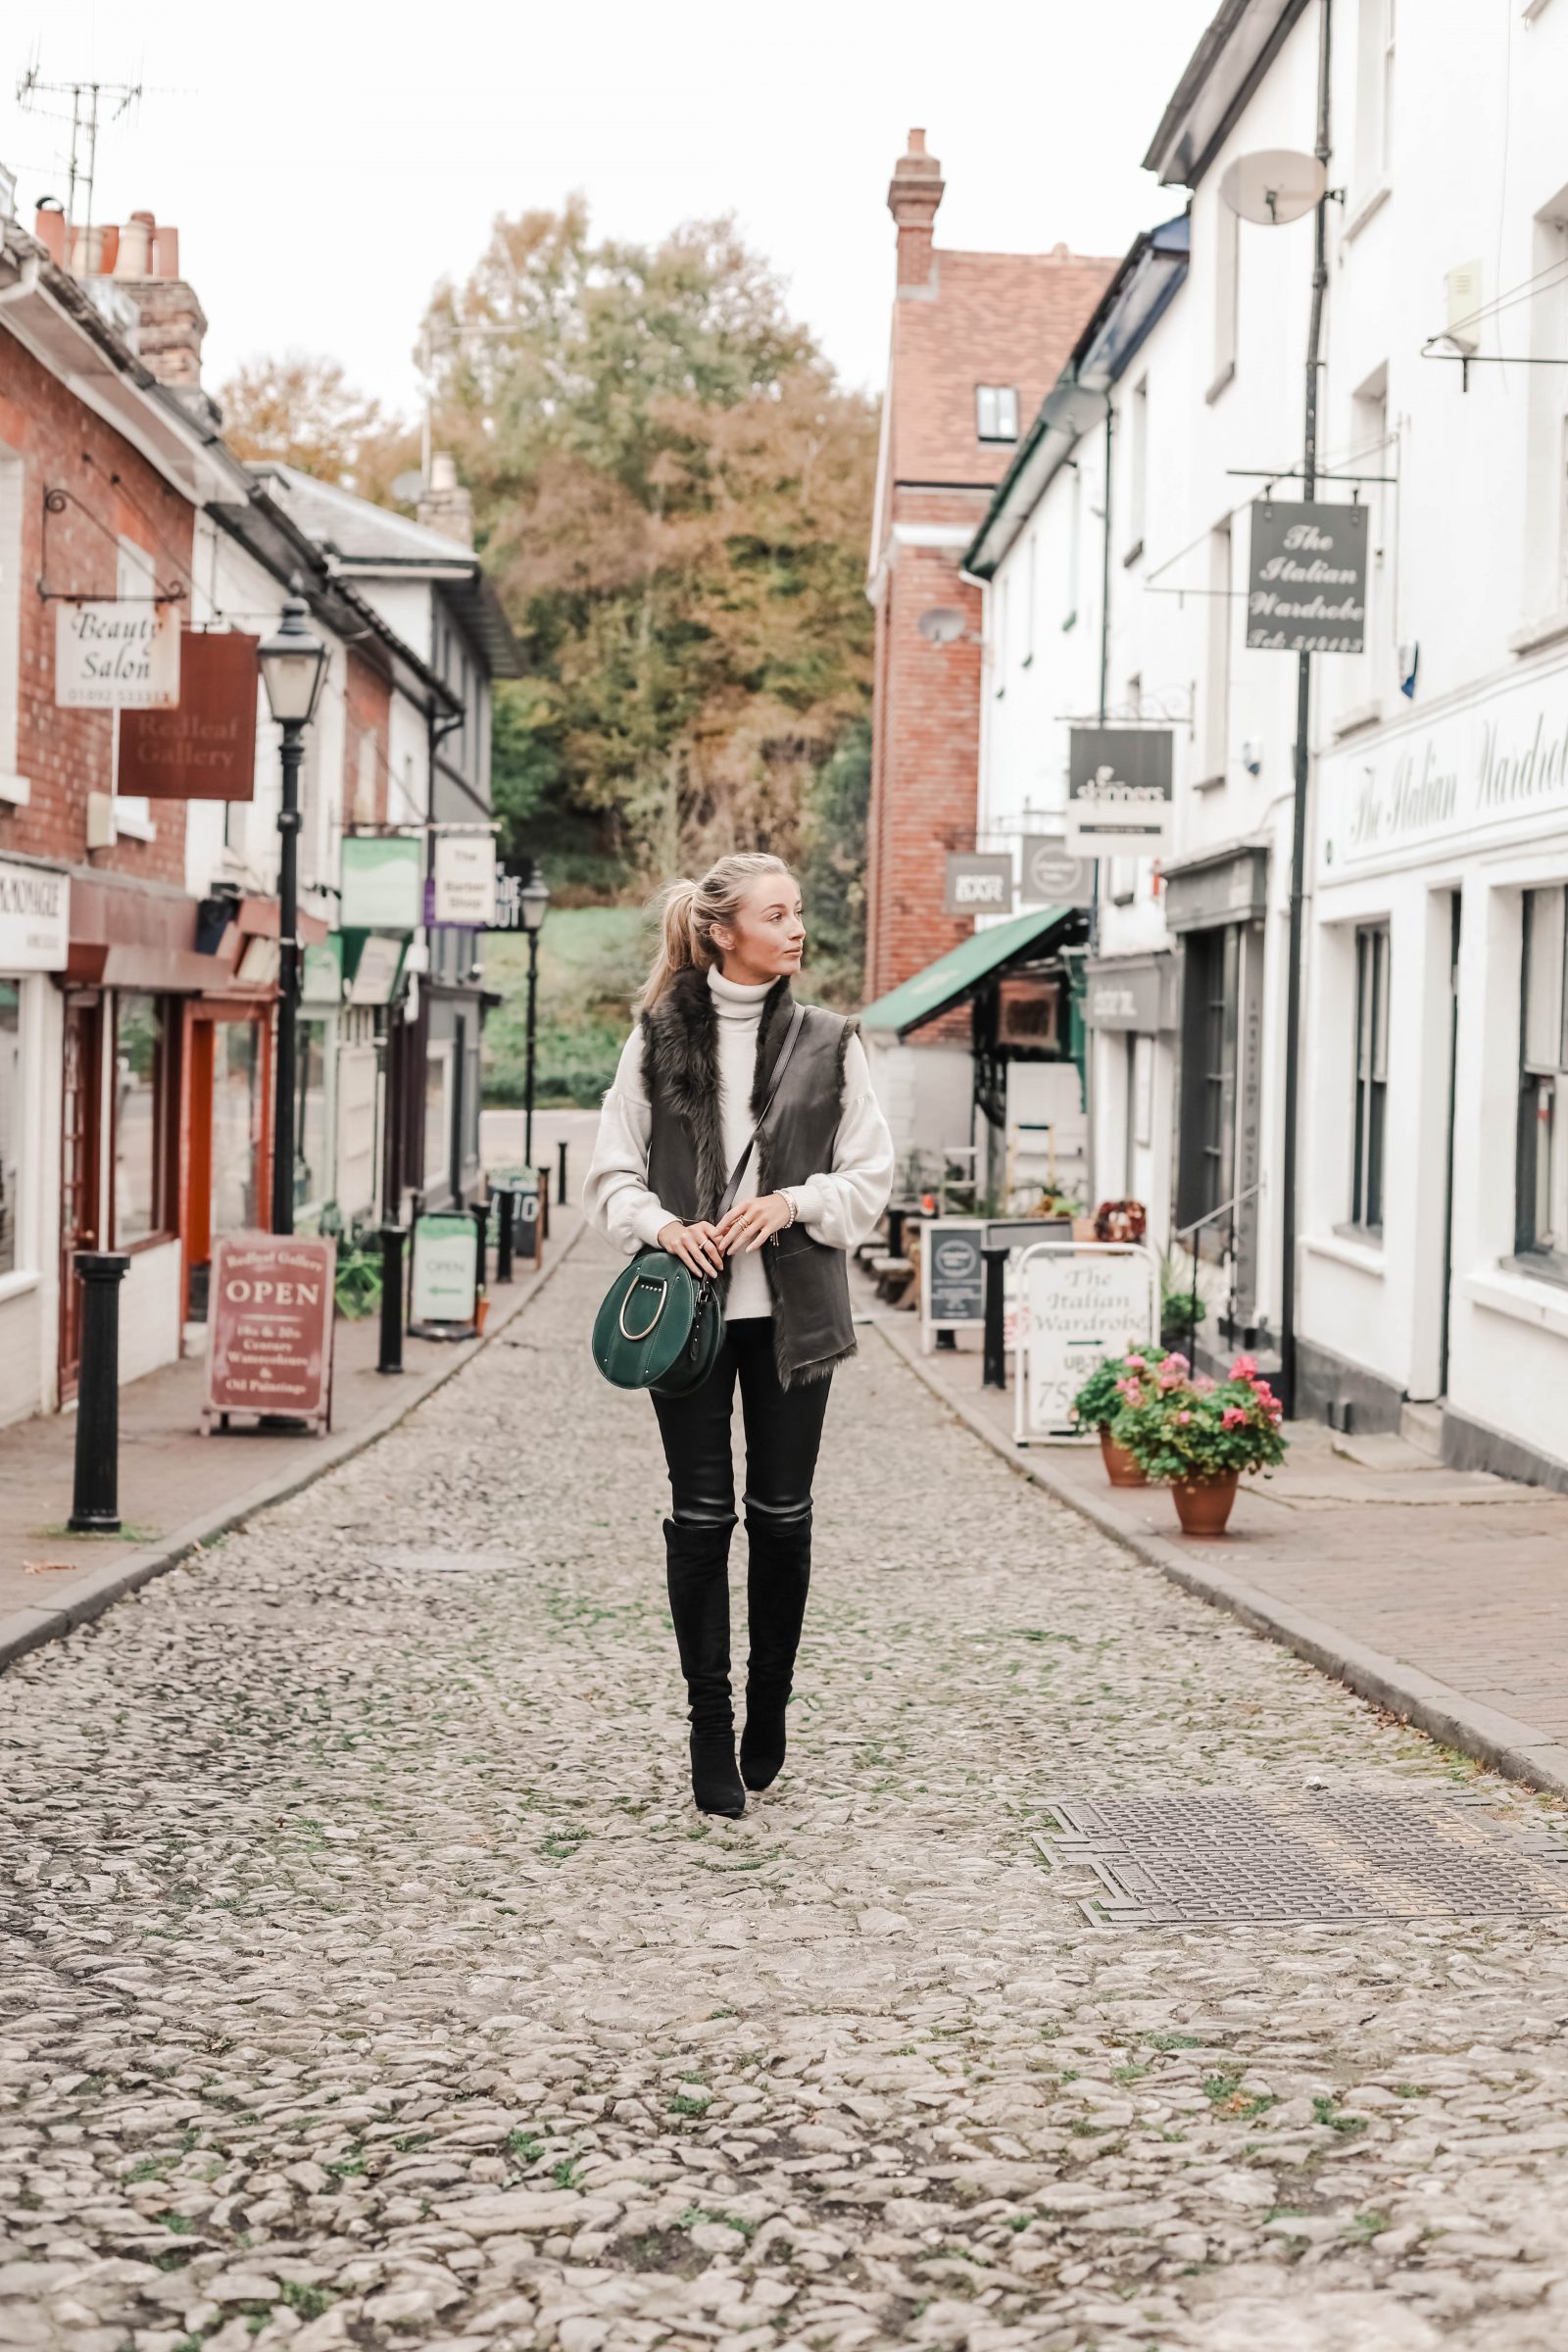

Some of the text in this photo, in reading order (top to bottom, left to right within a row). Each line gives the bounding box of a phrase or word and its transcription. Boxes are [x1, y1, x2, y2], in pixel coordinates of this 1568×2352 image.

[1283, 524, 1334, 551] The
[1258, 557, 1358, 585] Italian
[1249, 591, 1365, 621] Wardrobe
[71, 612, 163, 656] Beauty
[80, 642, 150, 679] Salon
[138, 713, 239, 740] Redleaf
[137, 740, 236, 767] Gallery
[277, 1251, 322, 1272] Gallery
[1065, 1266, 1112, 1288] The
[225, 1280, 319, 1306] OPEN
[1048, 1291, 1130, 1310] Italian
[1035, 1312, 1148, 1333] Wardrobe
